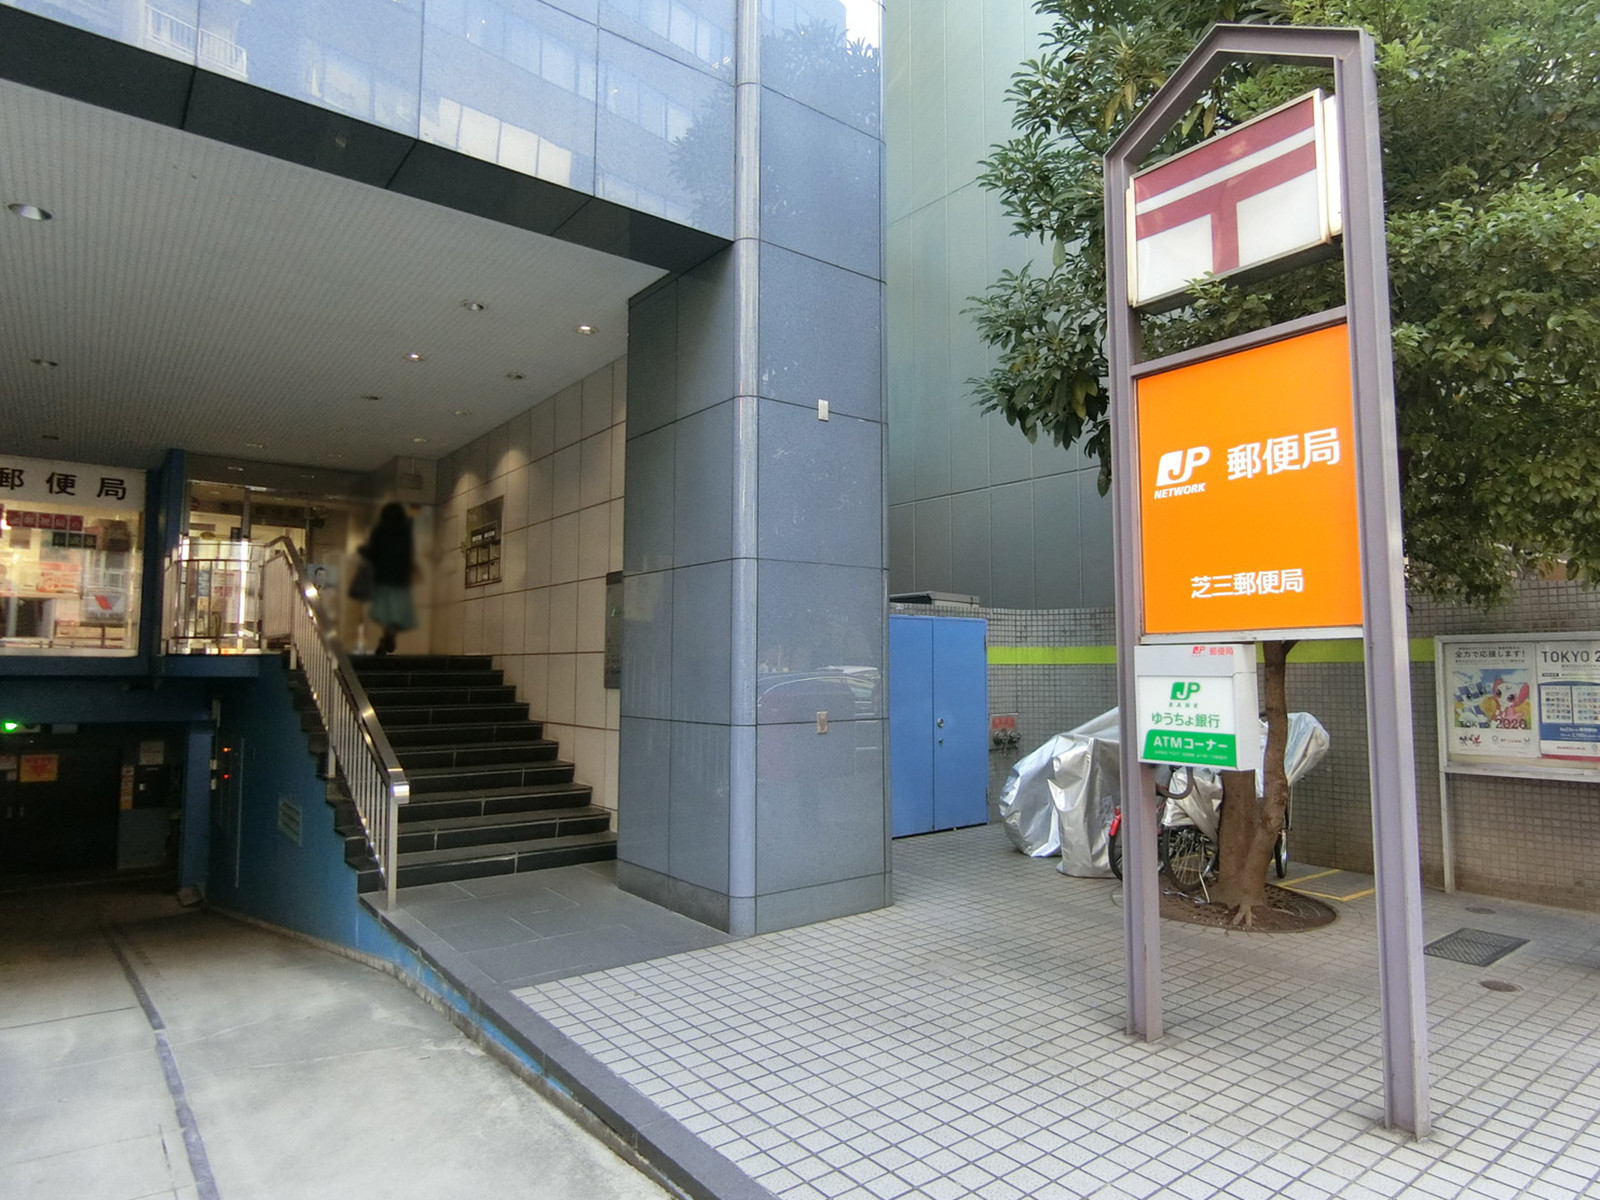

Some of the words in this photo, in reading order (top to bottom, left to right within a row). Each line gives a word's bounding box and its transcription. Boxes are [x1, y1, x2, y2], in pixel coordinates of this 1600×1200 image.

[1226, 427, 1341, 481] 郵便局
[0, 467, 127, 501] 郵便局
[1153, 482, 1206, 500] NETWORK
[1190, 568, 1305, 599] 芝三郵便局
[1541, 650, 1590, 663] TOKYO
[1151, 712, 1221, 729] ゆうちょ銀行
[1495, 718, 1527, 730] 2020
[1153, 736, 1228, 751] ATMコーナー
